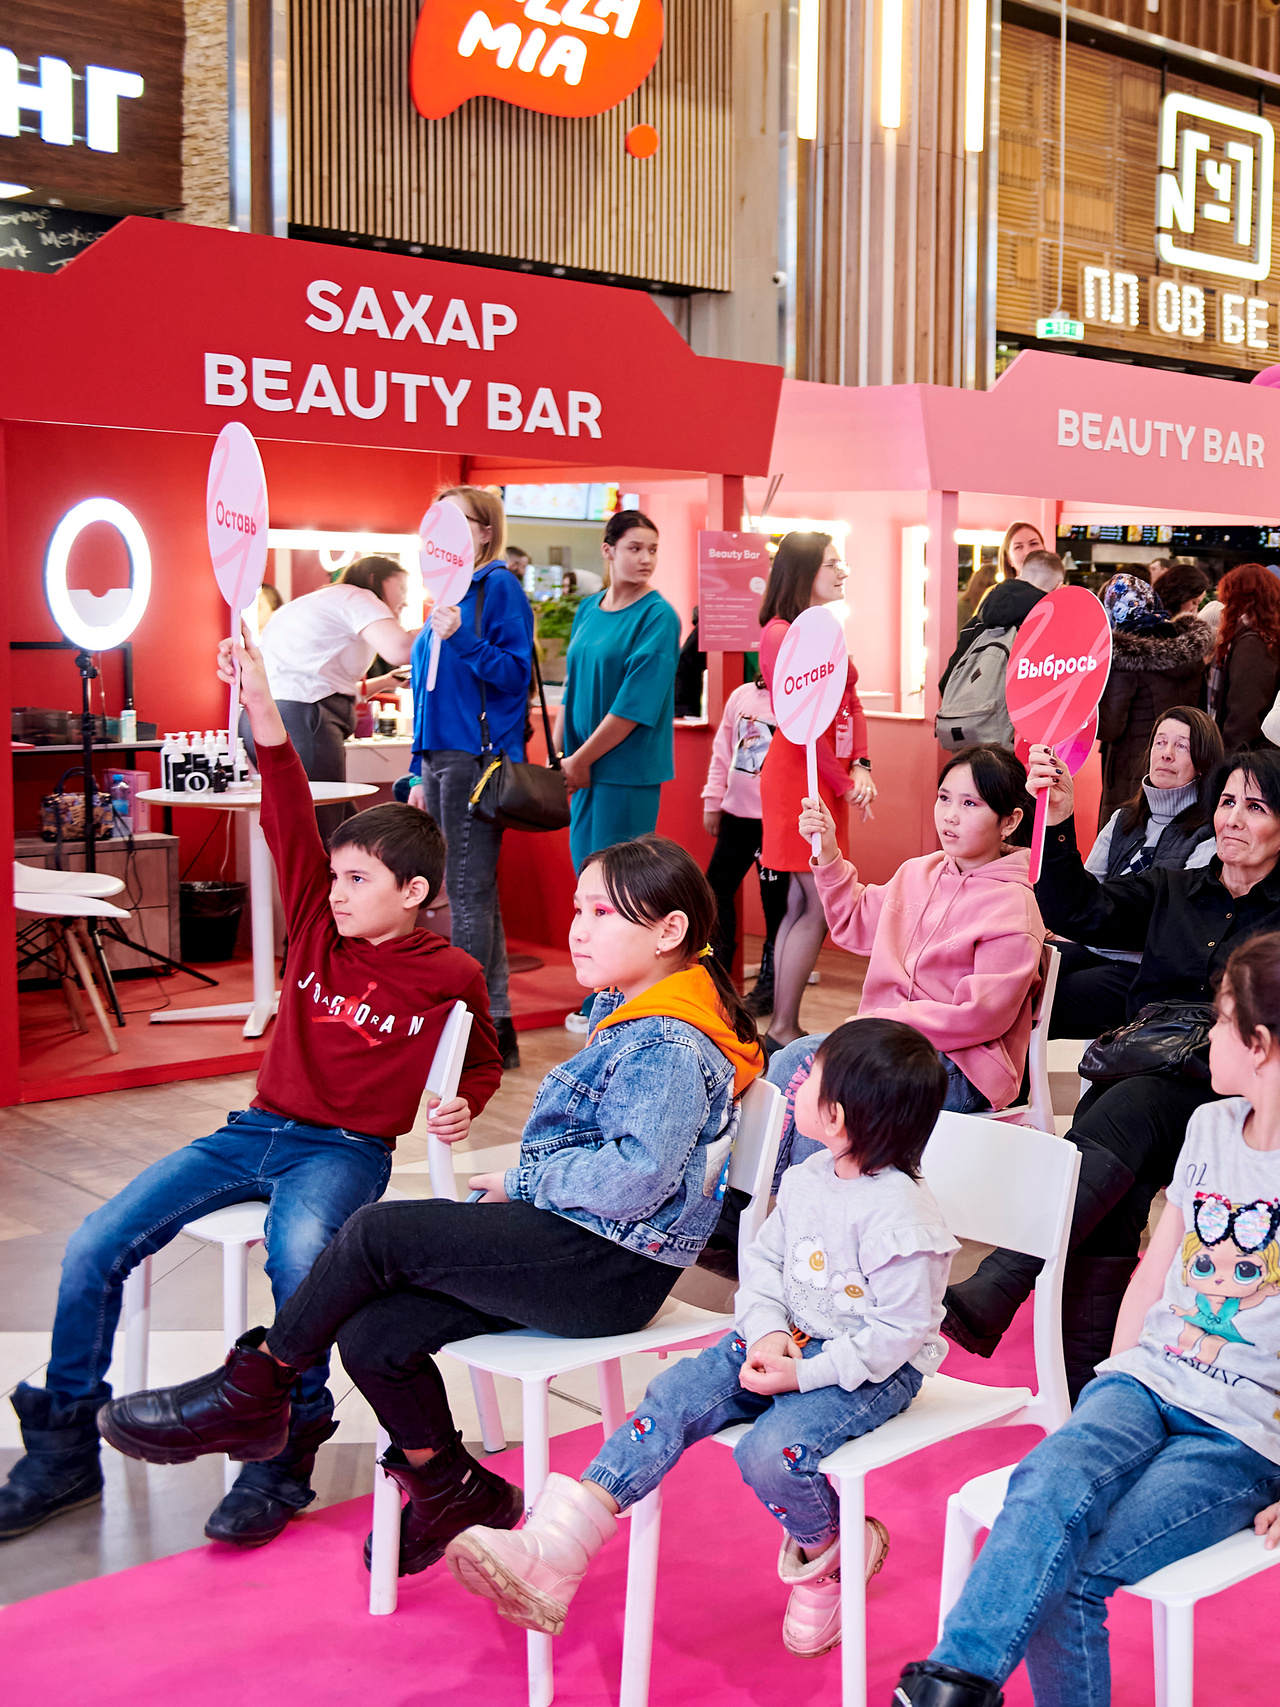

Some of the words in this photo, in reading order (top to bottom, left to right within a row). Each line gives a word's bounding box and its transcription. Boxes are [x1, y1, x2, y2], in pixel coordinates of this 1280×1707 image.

[457, 10, 588, 86] MIA
[203, 351, 473, 427] BEAUTY
[486, 381, 602, 439] BAR
[1057, 408, 1197, 461] BEAUTY
[1202, 427, 1266, 469] BAR
[215, 500, 257, 536] Оставь
[426, 540, 465, 568] Оставь
[708, 548, 743, 561] Beauty
[743, 549, 761, 561] Bar
[784, 661, 835, 696] Оставь
[1017, 653, 1098, 681] Выбрось
